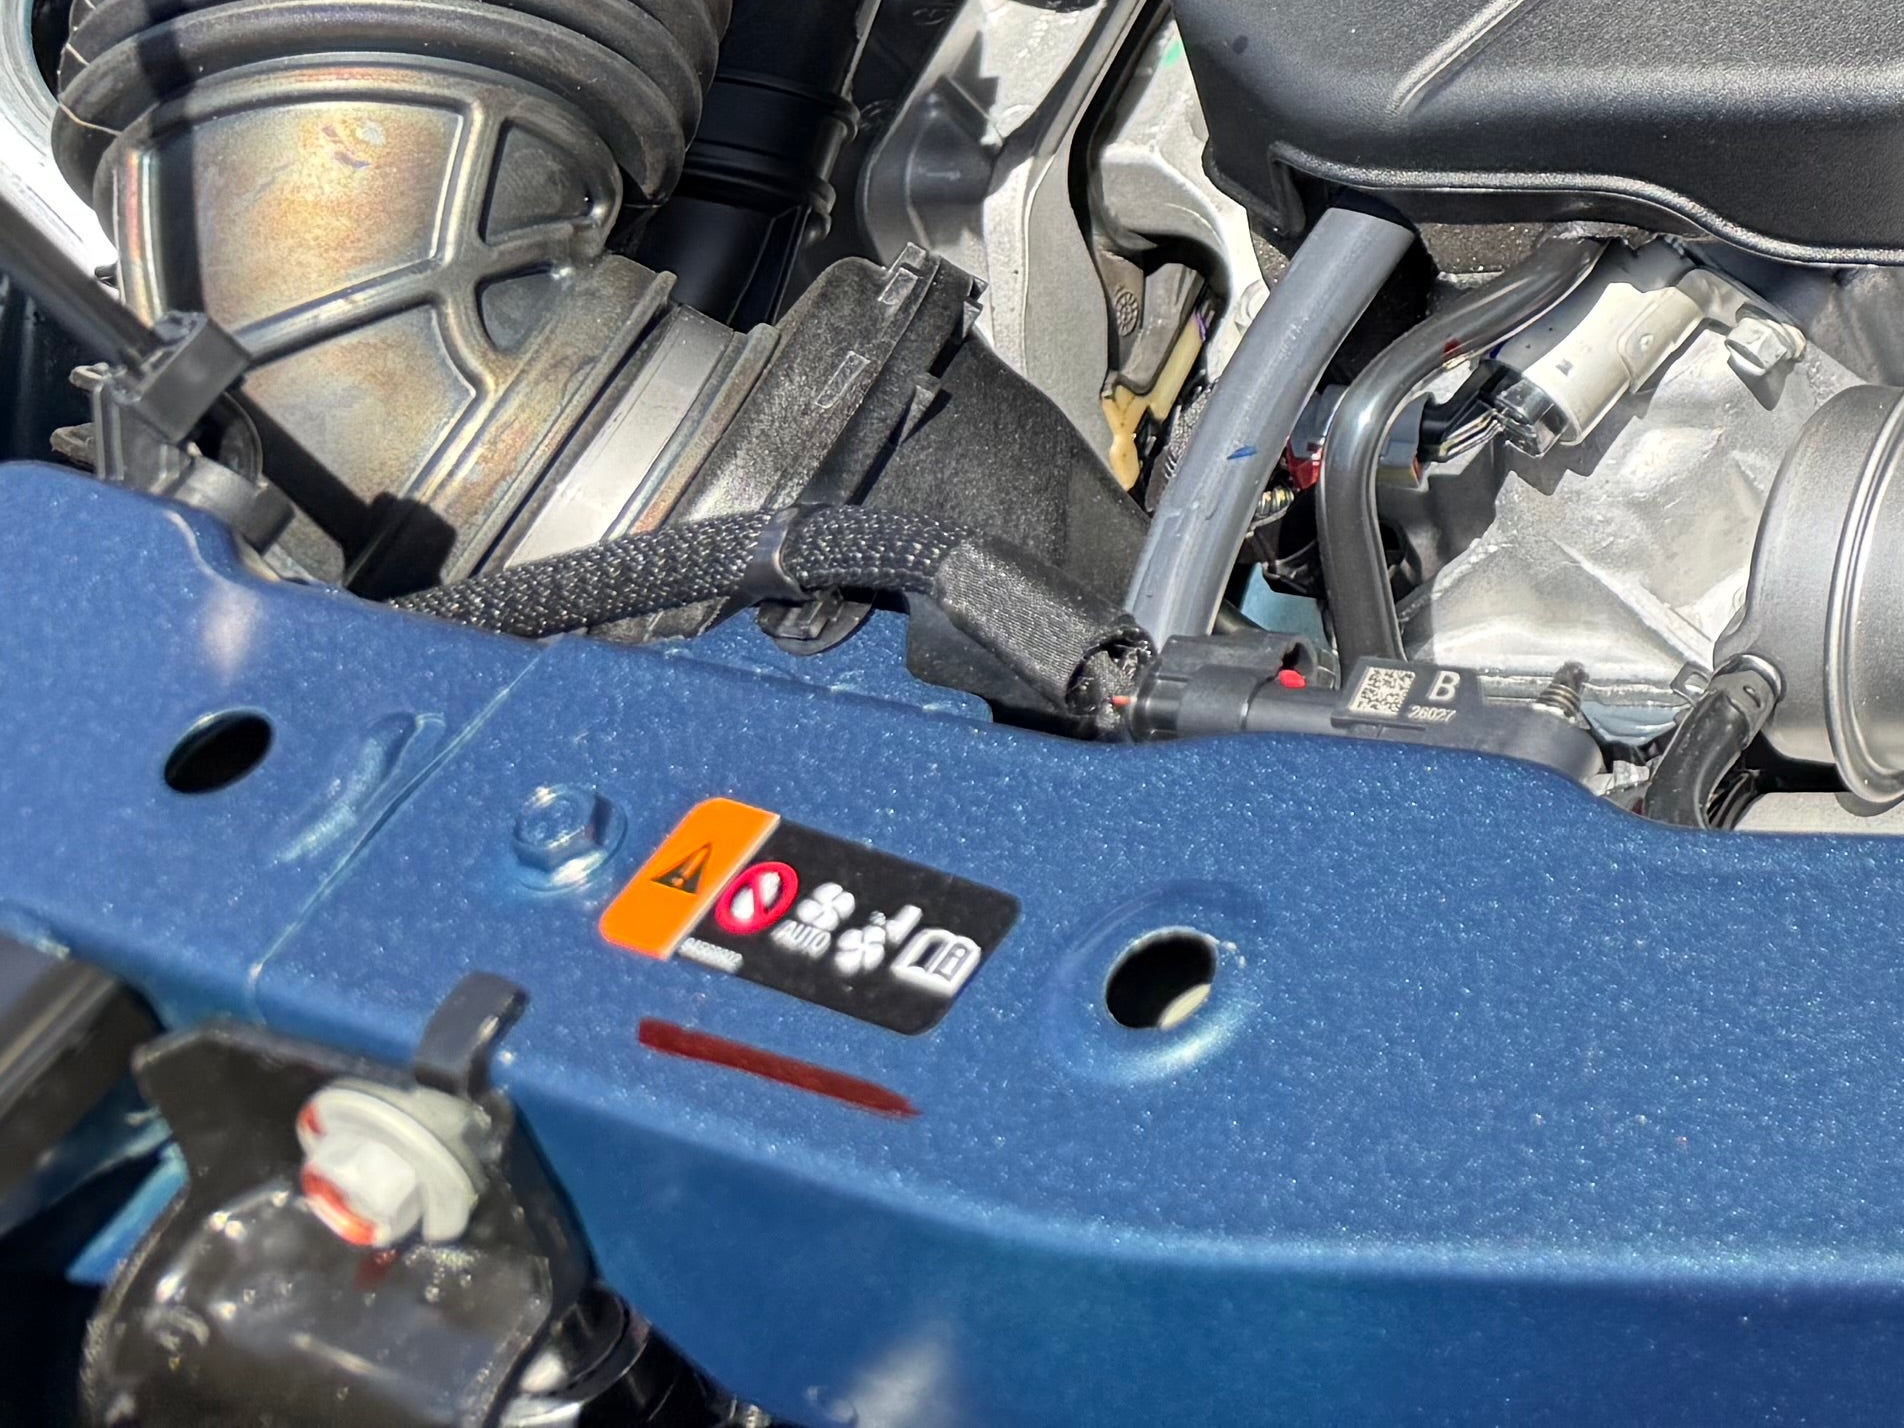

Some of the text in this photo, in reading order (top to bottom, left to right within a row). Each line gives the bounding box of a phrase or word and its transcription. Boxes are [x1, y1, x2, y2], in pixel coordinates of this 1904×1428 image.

[1427, 670, 1461, 703] B
[1407, 705, 1457, 723] 26027
[771, 919, 832, 960] AUTO
